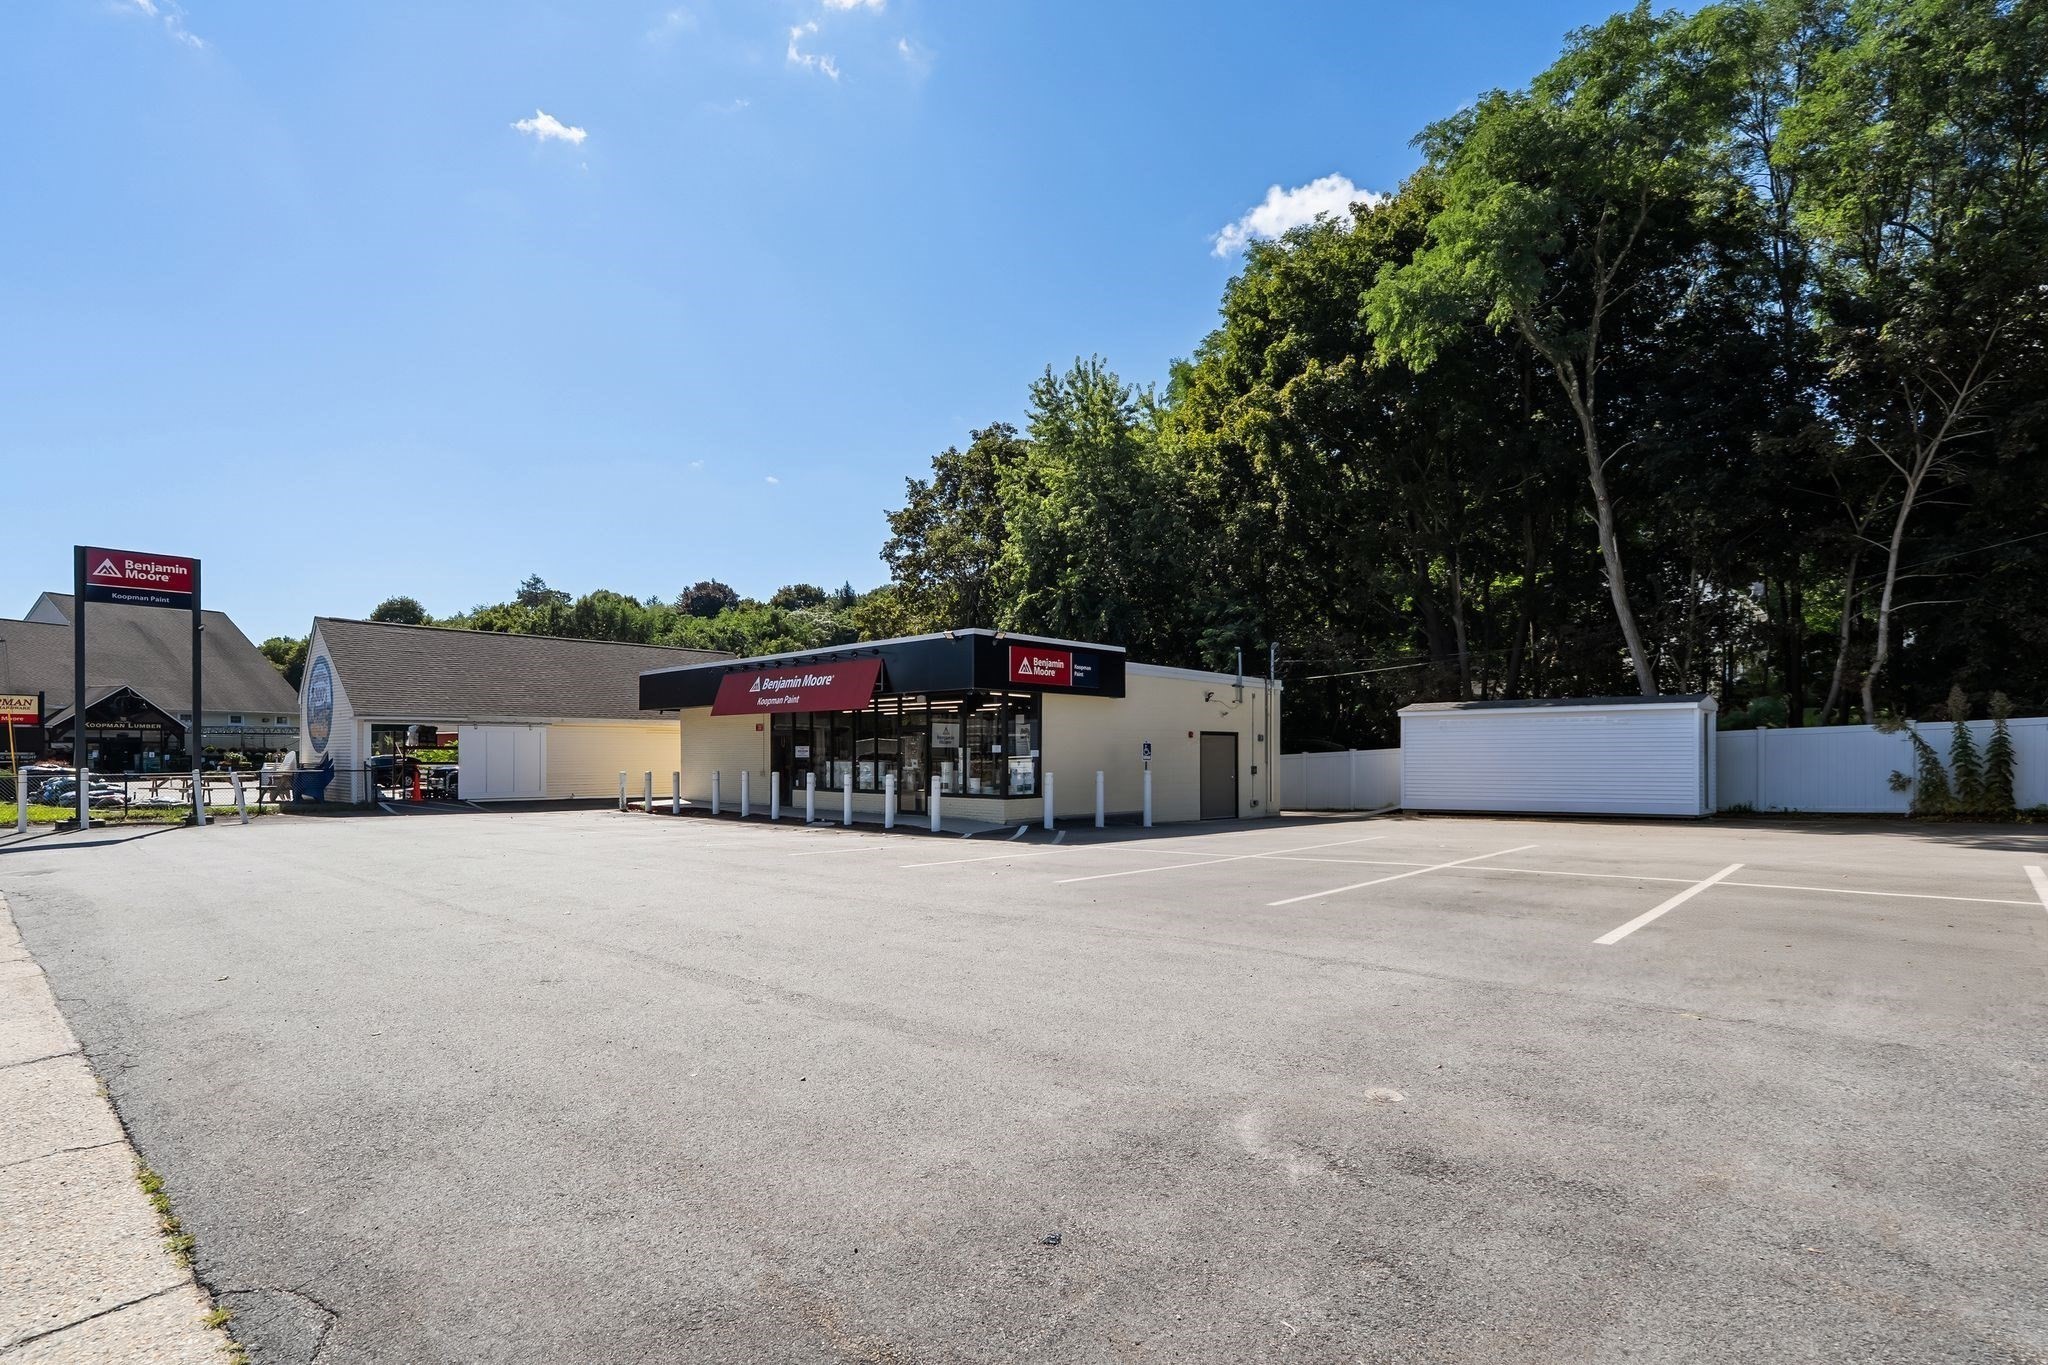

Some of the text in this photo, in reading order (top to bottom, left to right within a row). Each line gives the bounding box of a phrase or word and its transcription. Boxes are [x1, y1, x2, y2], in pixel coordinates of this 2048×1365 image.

[125, 560, 188, 575] Benjamin
[125, 570, 170, 582] Moore
[112, 592, 149, 602] Koopman
[1033, 657, 1064, 669] Benjamin
[1033, 667, 1056, 677] Moore
[762, 674, 833, 692] Benjamin Moore
[757, 695, 800, 707] Koopman Paint
